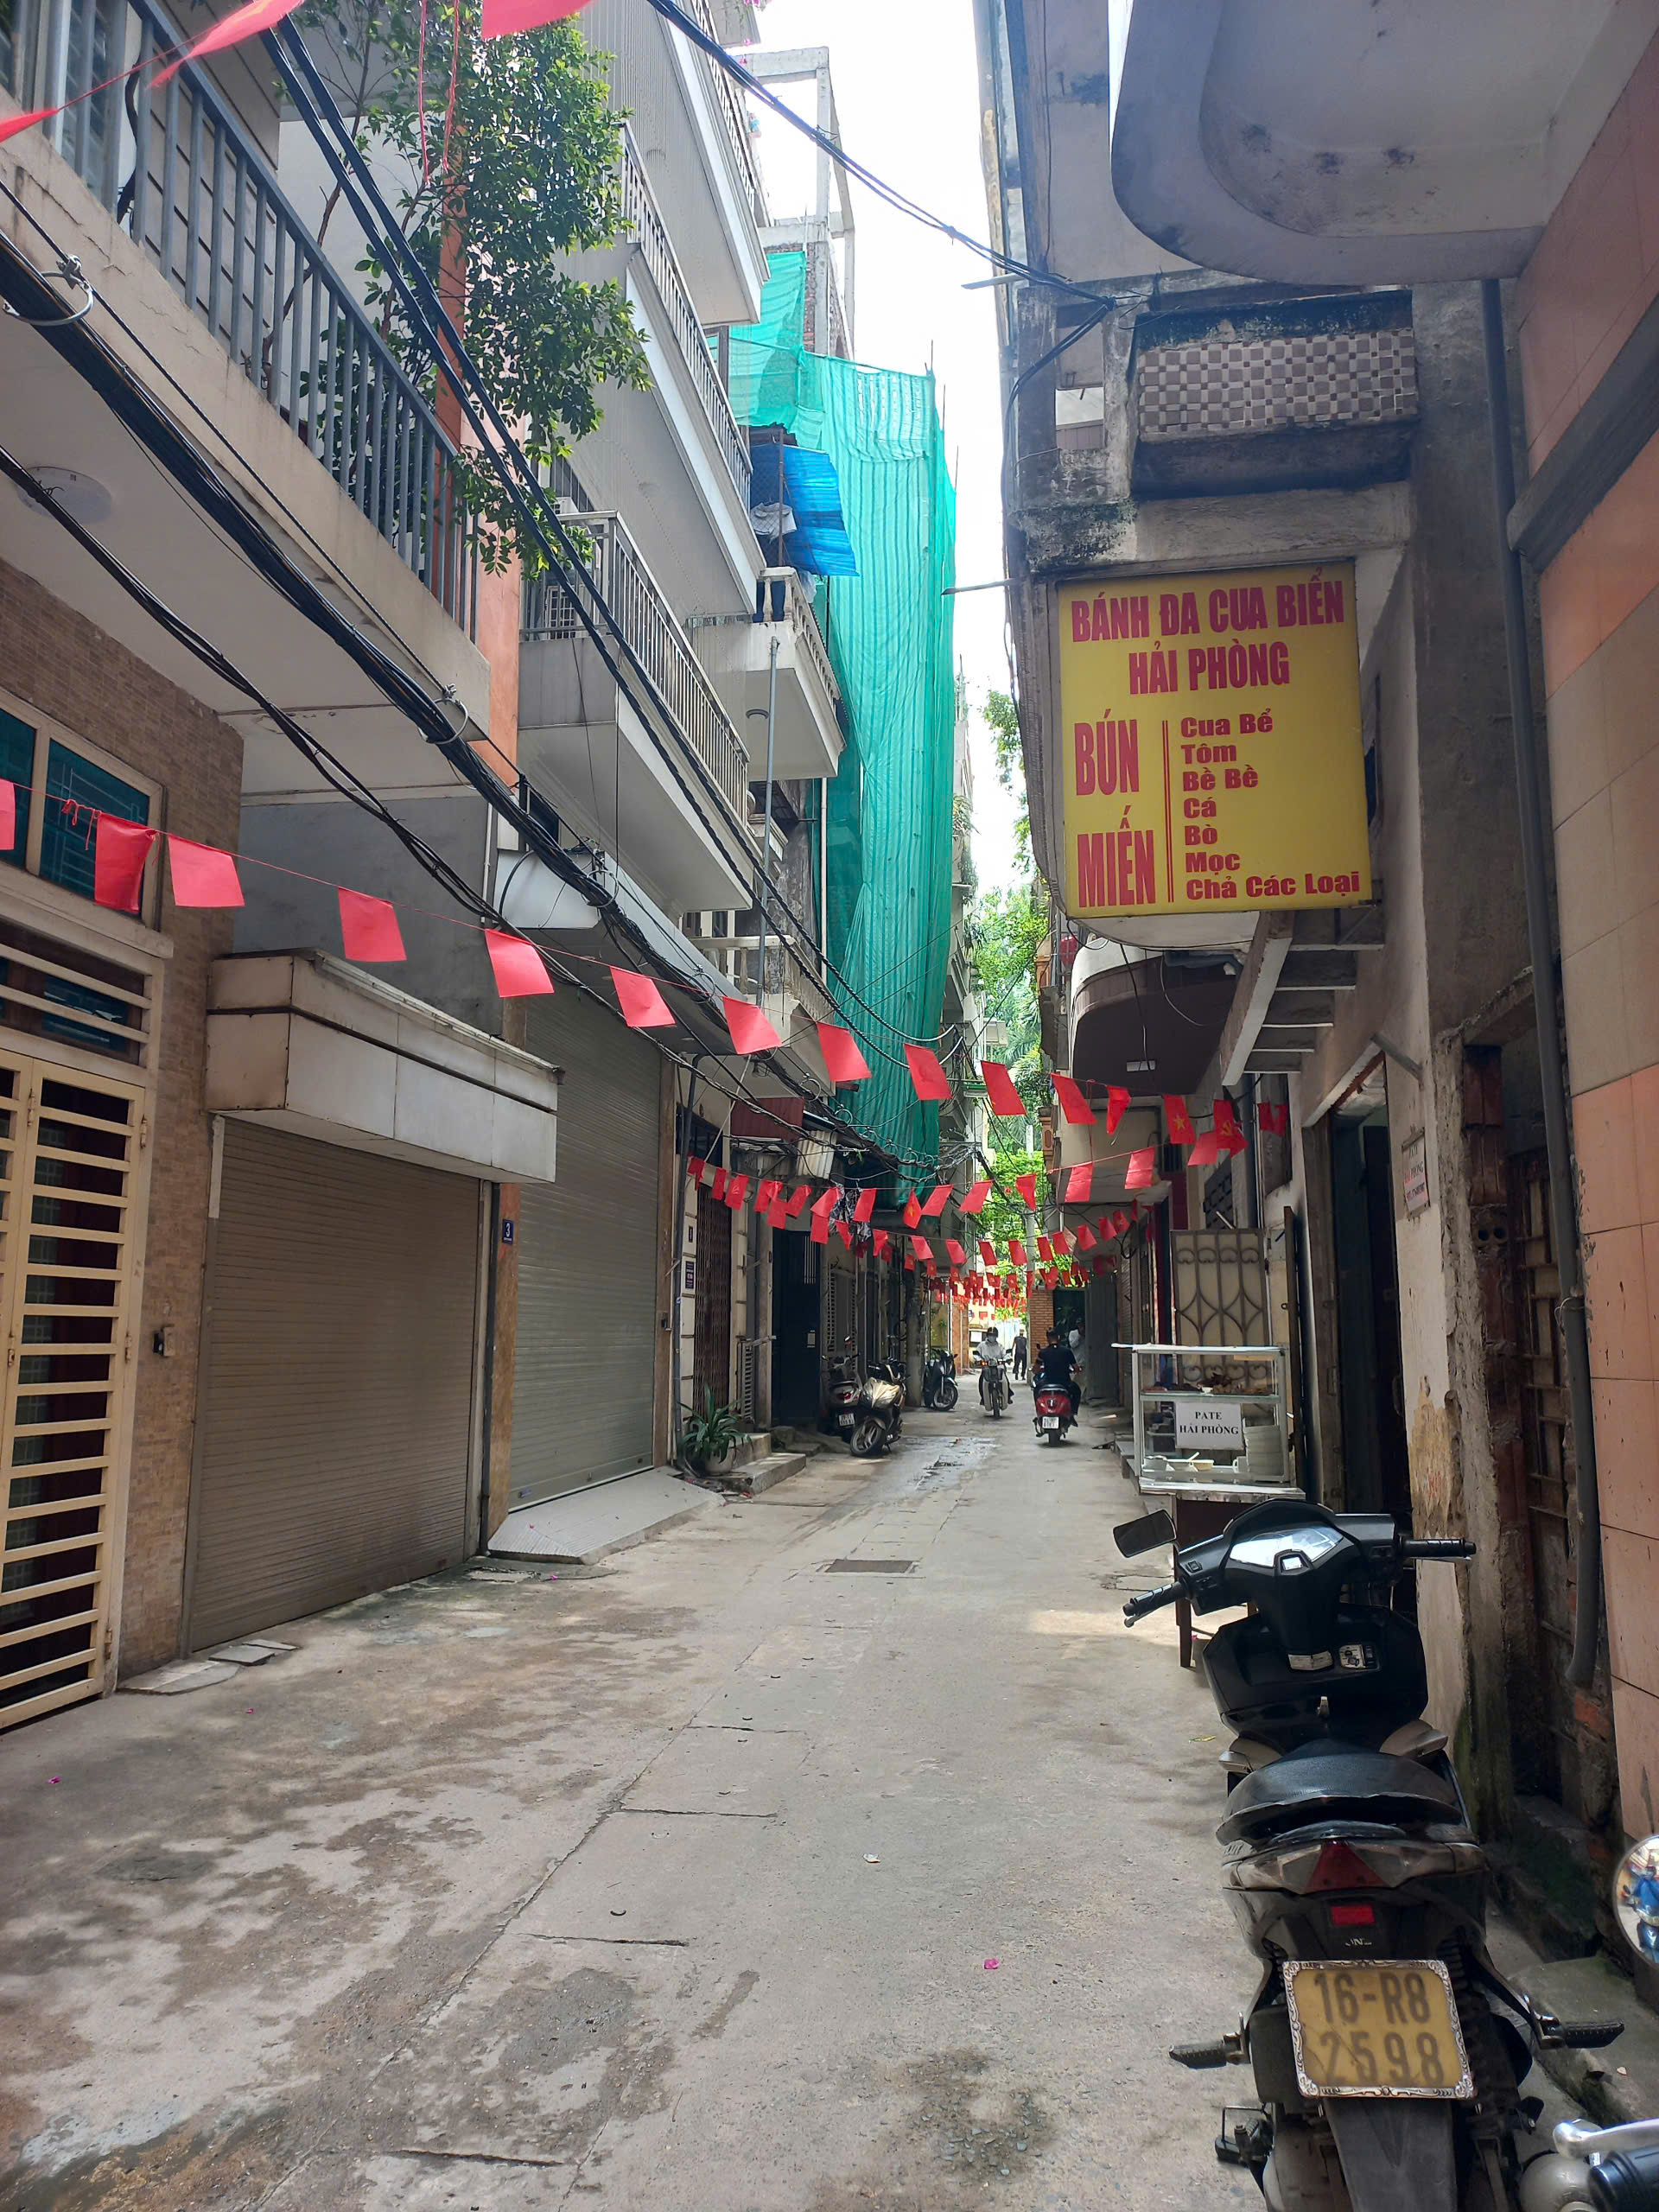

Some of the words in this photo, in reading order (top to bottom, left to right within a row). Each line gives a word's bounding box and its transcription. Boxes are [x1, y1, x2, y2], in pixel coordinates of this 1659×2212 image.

[1071, 591, 1149, 642] BÁNH
[1159, 592, 1200, 636] ĐA
[1209, 587, 1268, 633] CUA
[1276, 567, 1344, 627] BIỂN
[1128, 640, 1179, 695] HẢI
[1188, 639, 1290, 690] PHÒNG
[1180, 716, 1231, 738] Cua
[1239, 708, 1274, 734] Bể
[1074, 709, 1140, 797] BÚN
[1180, 743, 1237, 765] Tôm
[1182, 766, 1216, 791] Bề
[1224, 764, 1259, 789] Bề
[1183, 797, 1217, 818] Cá
[1184, 823, 1218, 846] Bò
[1077, 804, 1156, 908] MIẾN
[1185, 851, 1241, 876] Mọc
[1186, 876, 1237, 900] Chả
[1245, 874, 1296, 897] Các
[1305, 871, 1361, 897] Loại
[505, 1223, 511, 1237] 3
[1195, 1411, 1223, 1420] PATE
[1201, 1424, 1239, 1434] PHÒNG
[1314, 1973, 1431, 2024] 16-R8
[1320, 2031, 1444, 2087] 2598
